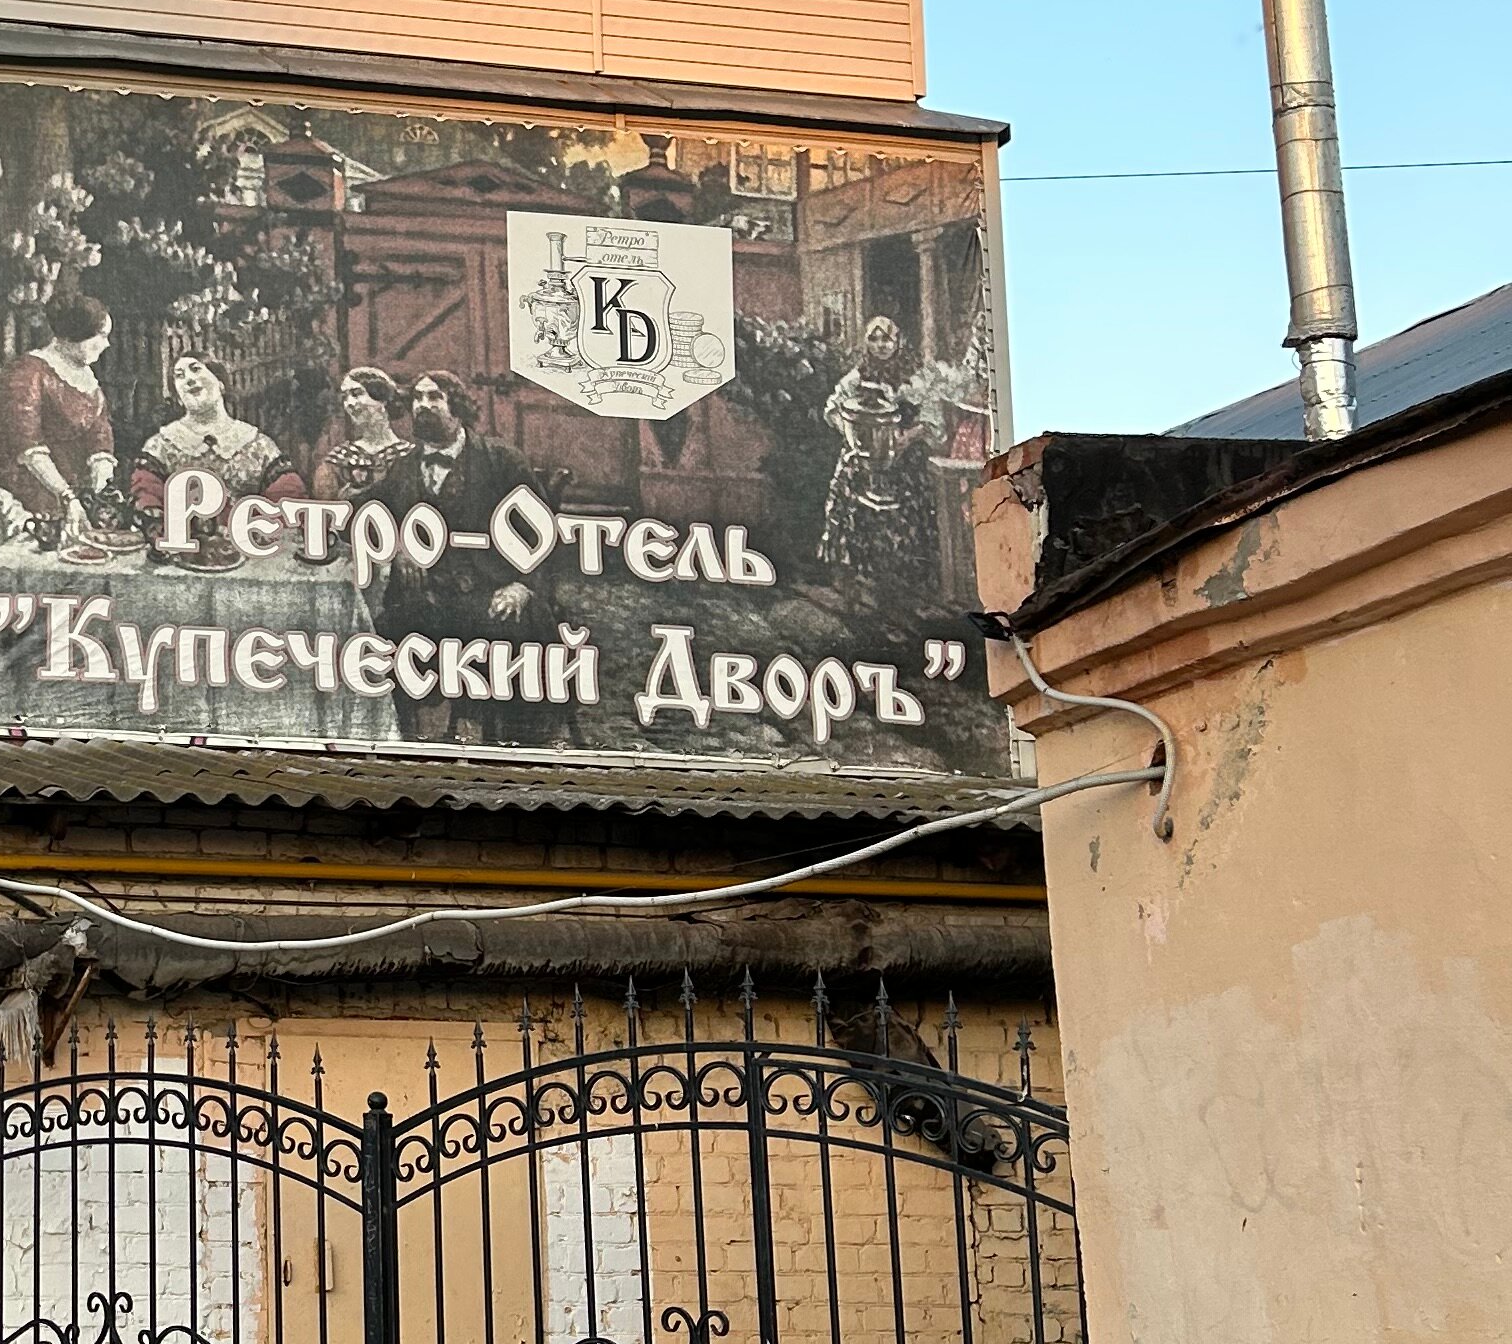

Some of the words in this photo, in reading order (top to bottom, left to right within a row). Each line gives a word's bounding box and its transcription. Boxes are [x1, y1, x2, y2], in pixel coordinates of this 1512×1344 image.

[599, 228, 645, 249] Ретро
[602, 253, 644, 266] отель
[157, 468, 777, 589] Ретро-Отель
